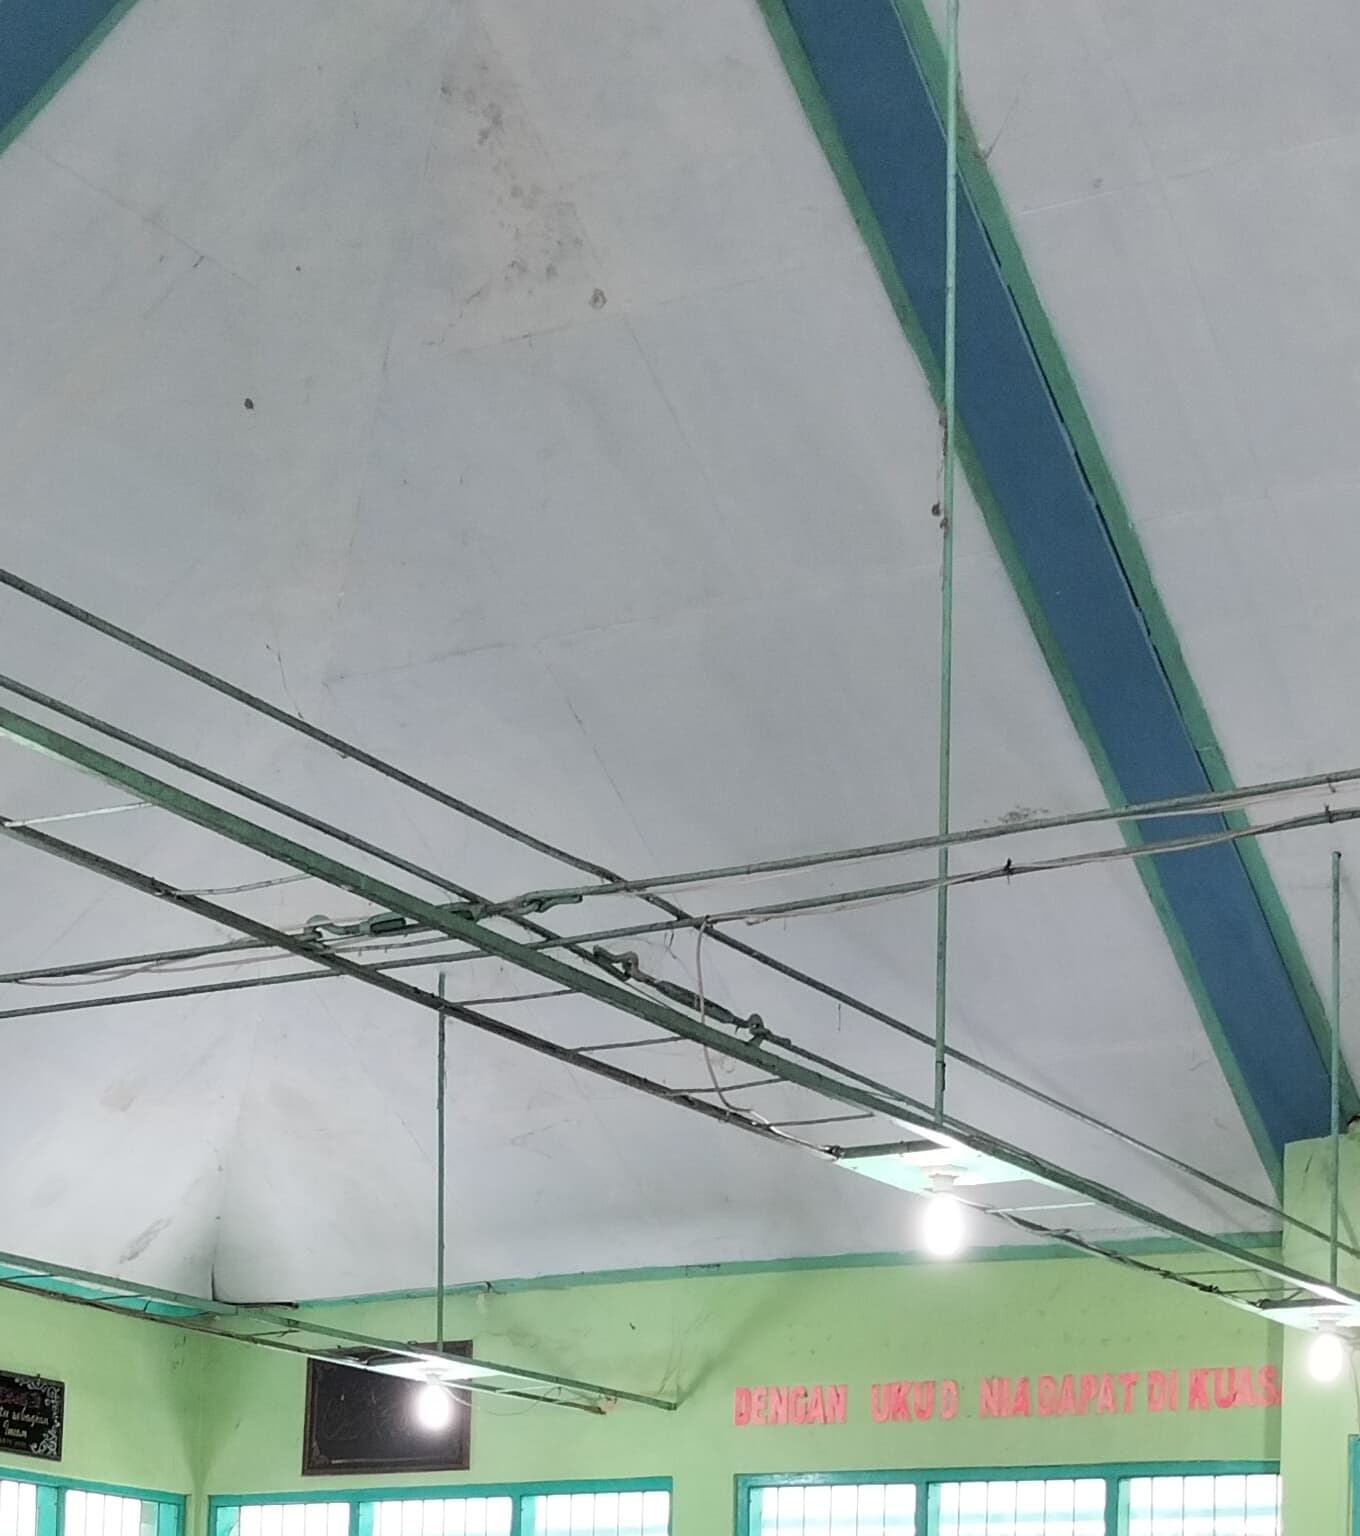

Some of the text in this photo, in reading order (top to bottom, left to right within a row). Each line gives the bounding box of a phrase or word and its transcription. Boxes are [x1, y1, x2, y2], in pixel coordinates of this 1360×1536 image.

[734, 1384, 848, 1426] DENGAN
[1037, 1372, 1139, 1417] DAPAT
[1147, 1370, 1178, 1412] DI
[1188, 1364, 1282, 1411] KUAS
